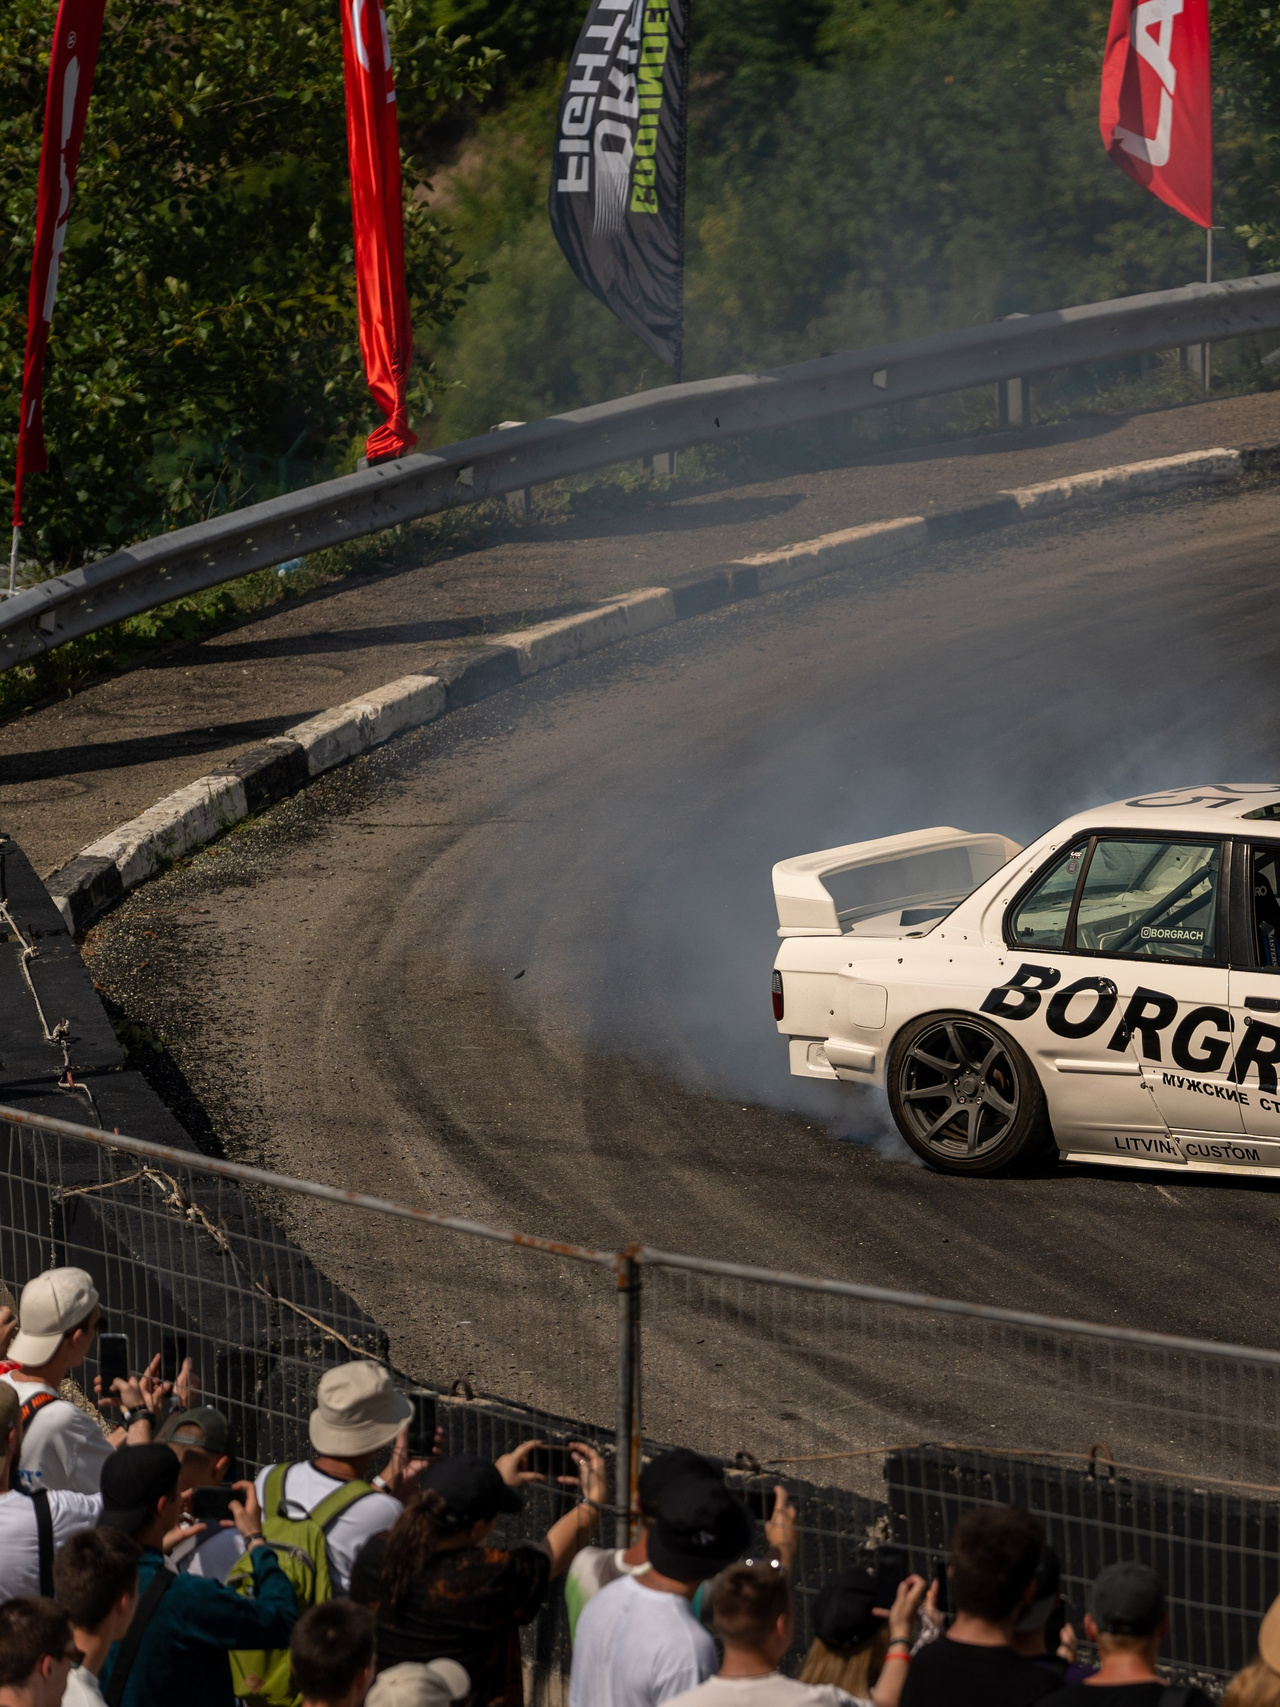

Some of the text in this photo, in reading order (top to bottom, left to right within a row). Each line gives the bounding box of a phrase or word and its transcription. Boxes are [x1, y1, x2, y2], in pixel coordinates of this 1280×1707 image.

[1150, 928, 1204, 941] BORGRACH
[1162, 1072, 1250, 1106] МУЖСКИЕ
[1114, 1136, 1261, 1161] LITVIN CUSTOM
